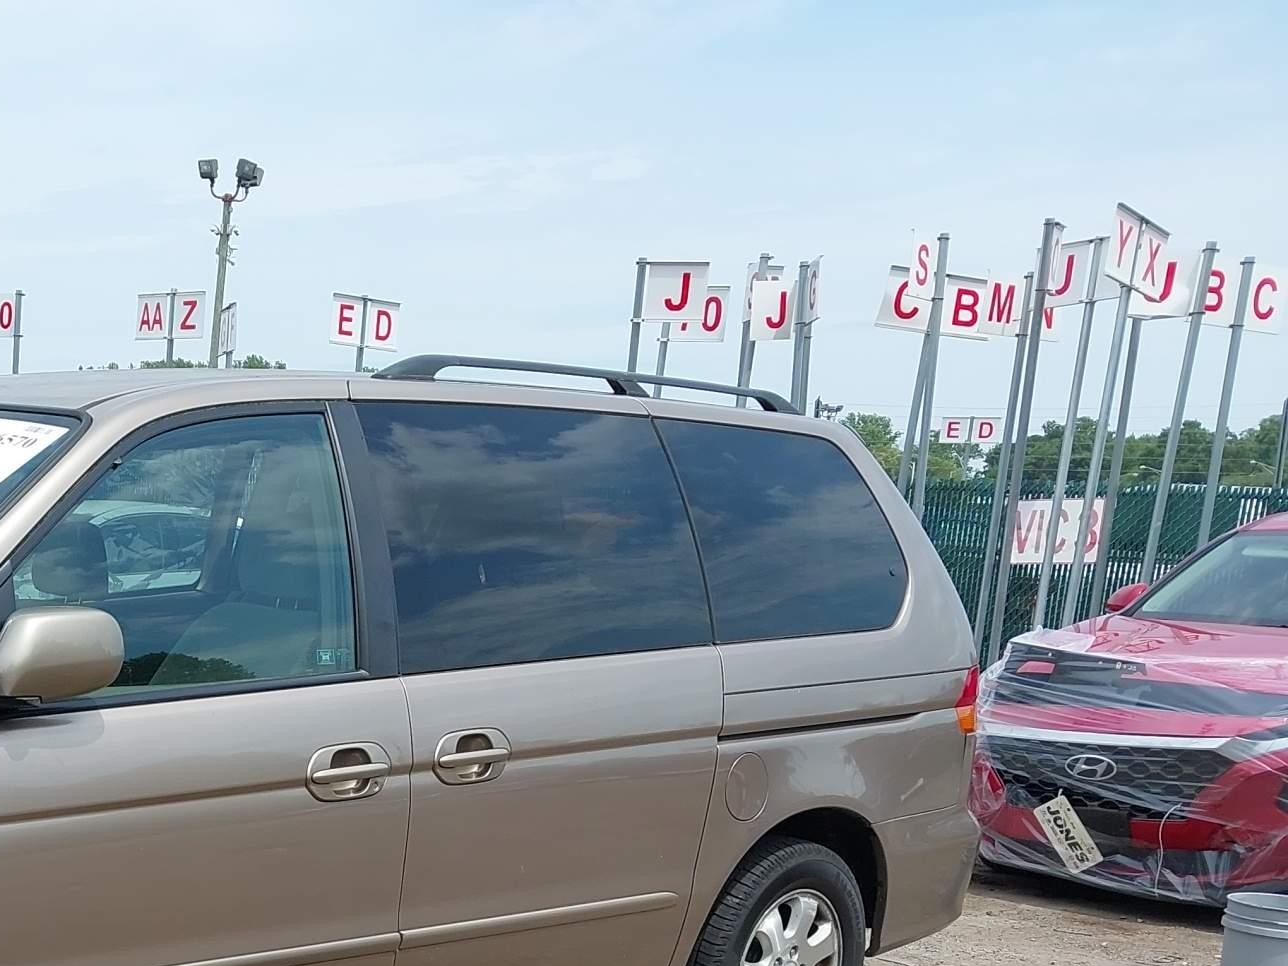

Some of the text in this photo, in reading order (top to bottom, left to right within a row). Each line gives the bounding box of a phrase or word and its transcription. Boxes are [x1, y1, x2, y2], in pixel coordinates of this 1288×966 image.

[916, 244, 929, 286] S
[1117, 219, 1161, 287] Y X
[665, 272, 691, 312] J
[1048, 254, 1075, 296] J
[1143, 261, 1177, 304] J
[139, 300, 198, 332] AA Z
[766, 291, 787, 329] J
[894, 280, 980, 327] C B
[988, 282, 1016, 324] M
[1253, 277, 1278, 320] C
[338, 303, 393, 341] E D
[946, 421, 993, 439] E D
[1046, 805, 1090, 864] JONES
